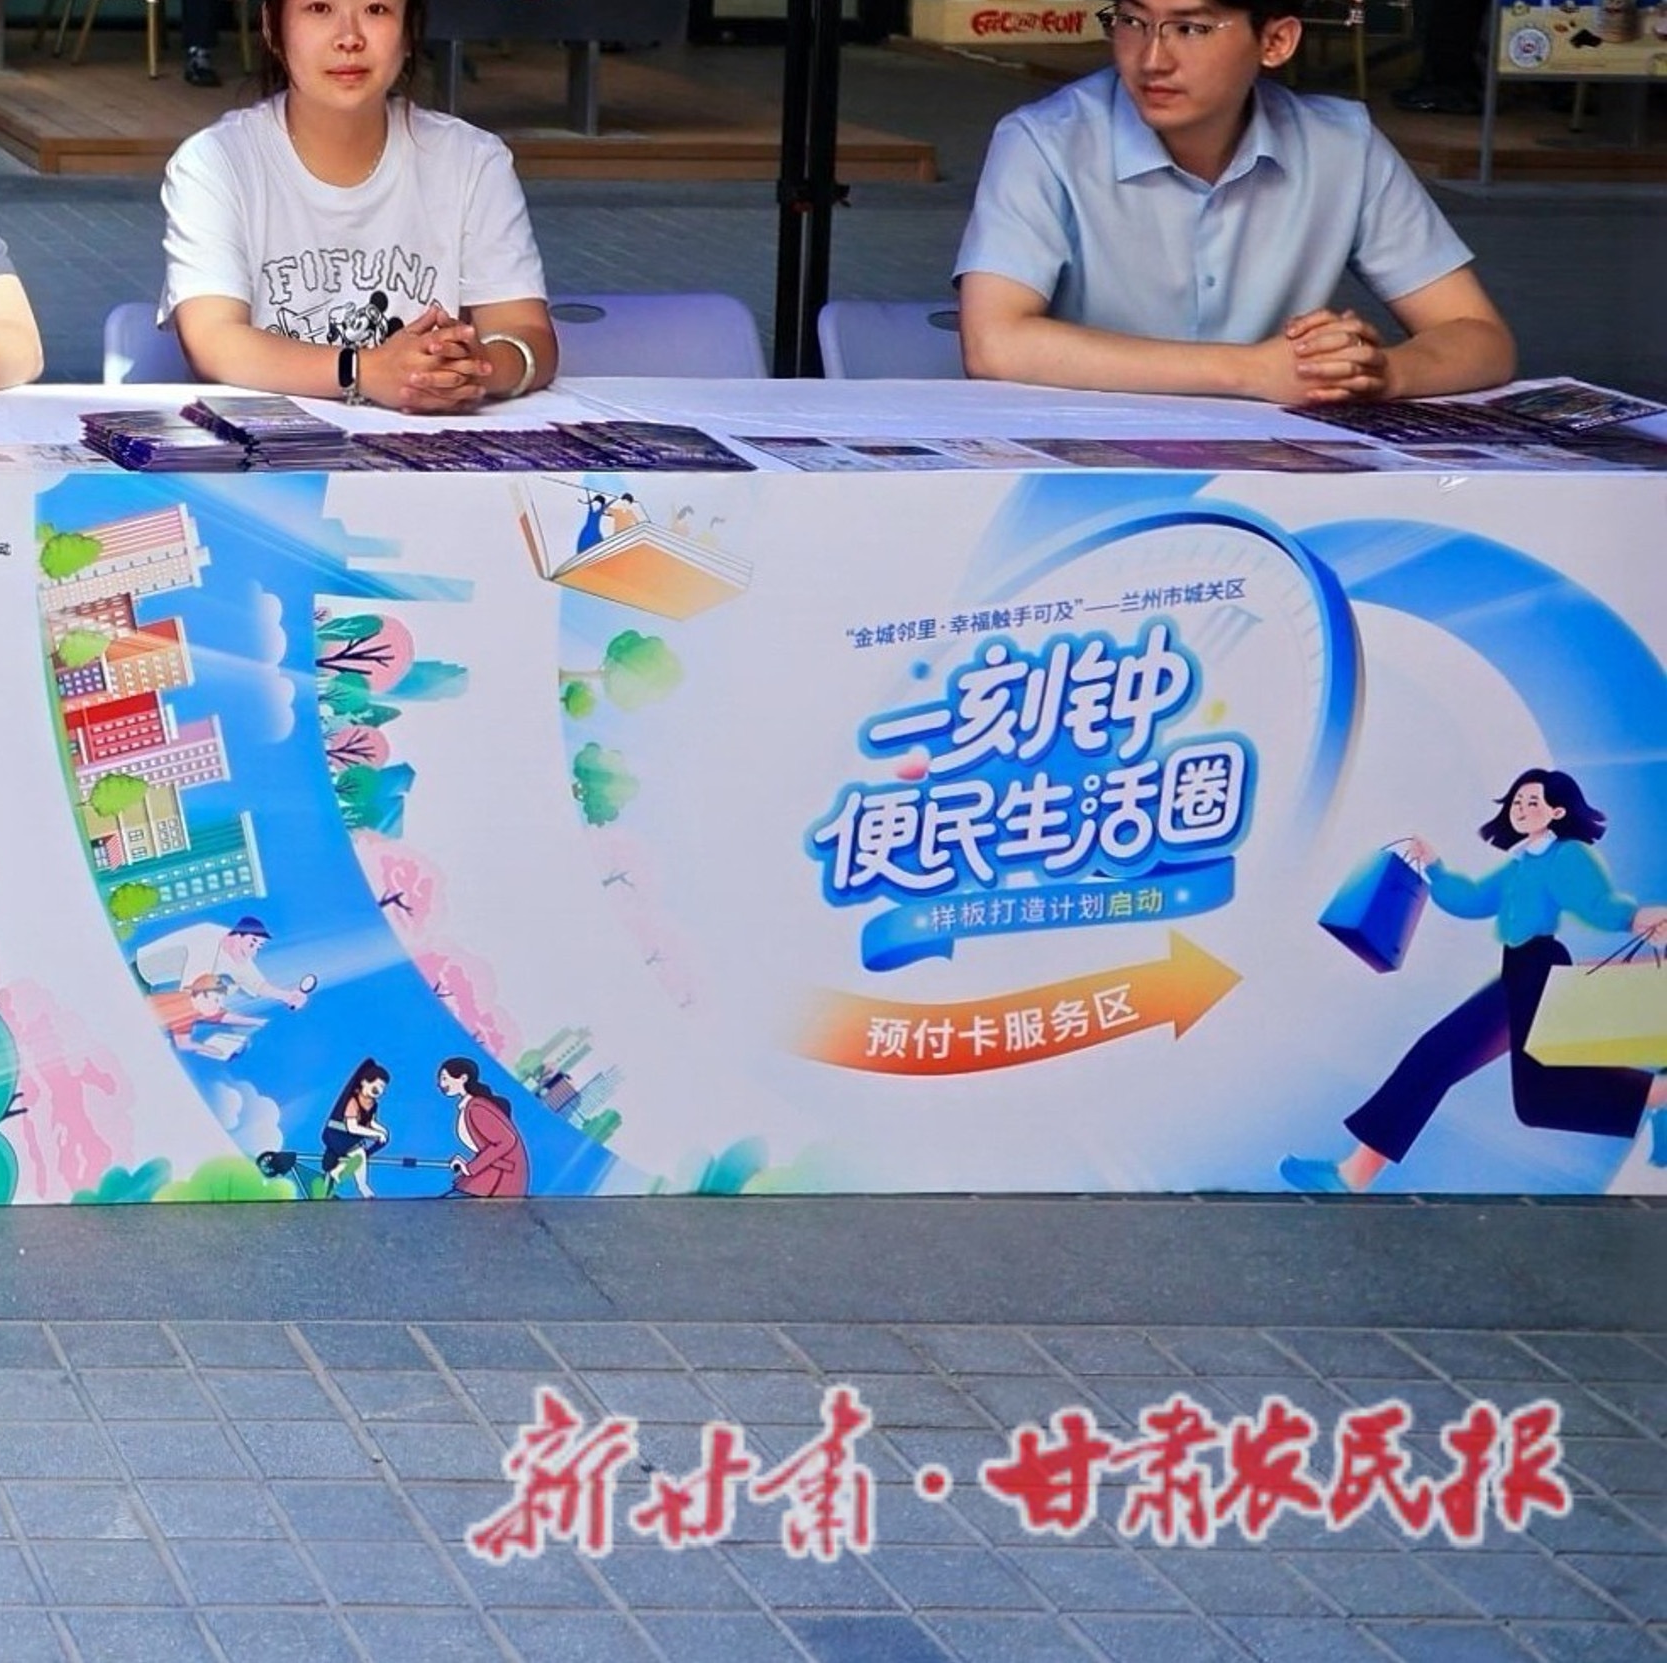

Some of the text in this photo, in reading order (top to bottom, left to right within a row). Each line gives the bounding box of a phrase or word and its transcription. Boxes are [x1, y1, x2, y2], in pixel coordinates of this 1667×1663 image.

[869, 624, 1191, 774] 一刻钟
[814, 739, 1246, 890] 便民生活圈
[930, 887, 1164, 933] 样板打造计划启动
[864, 983, 1140, 1060] 预付卡服务区
